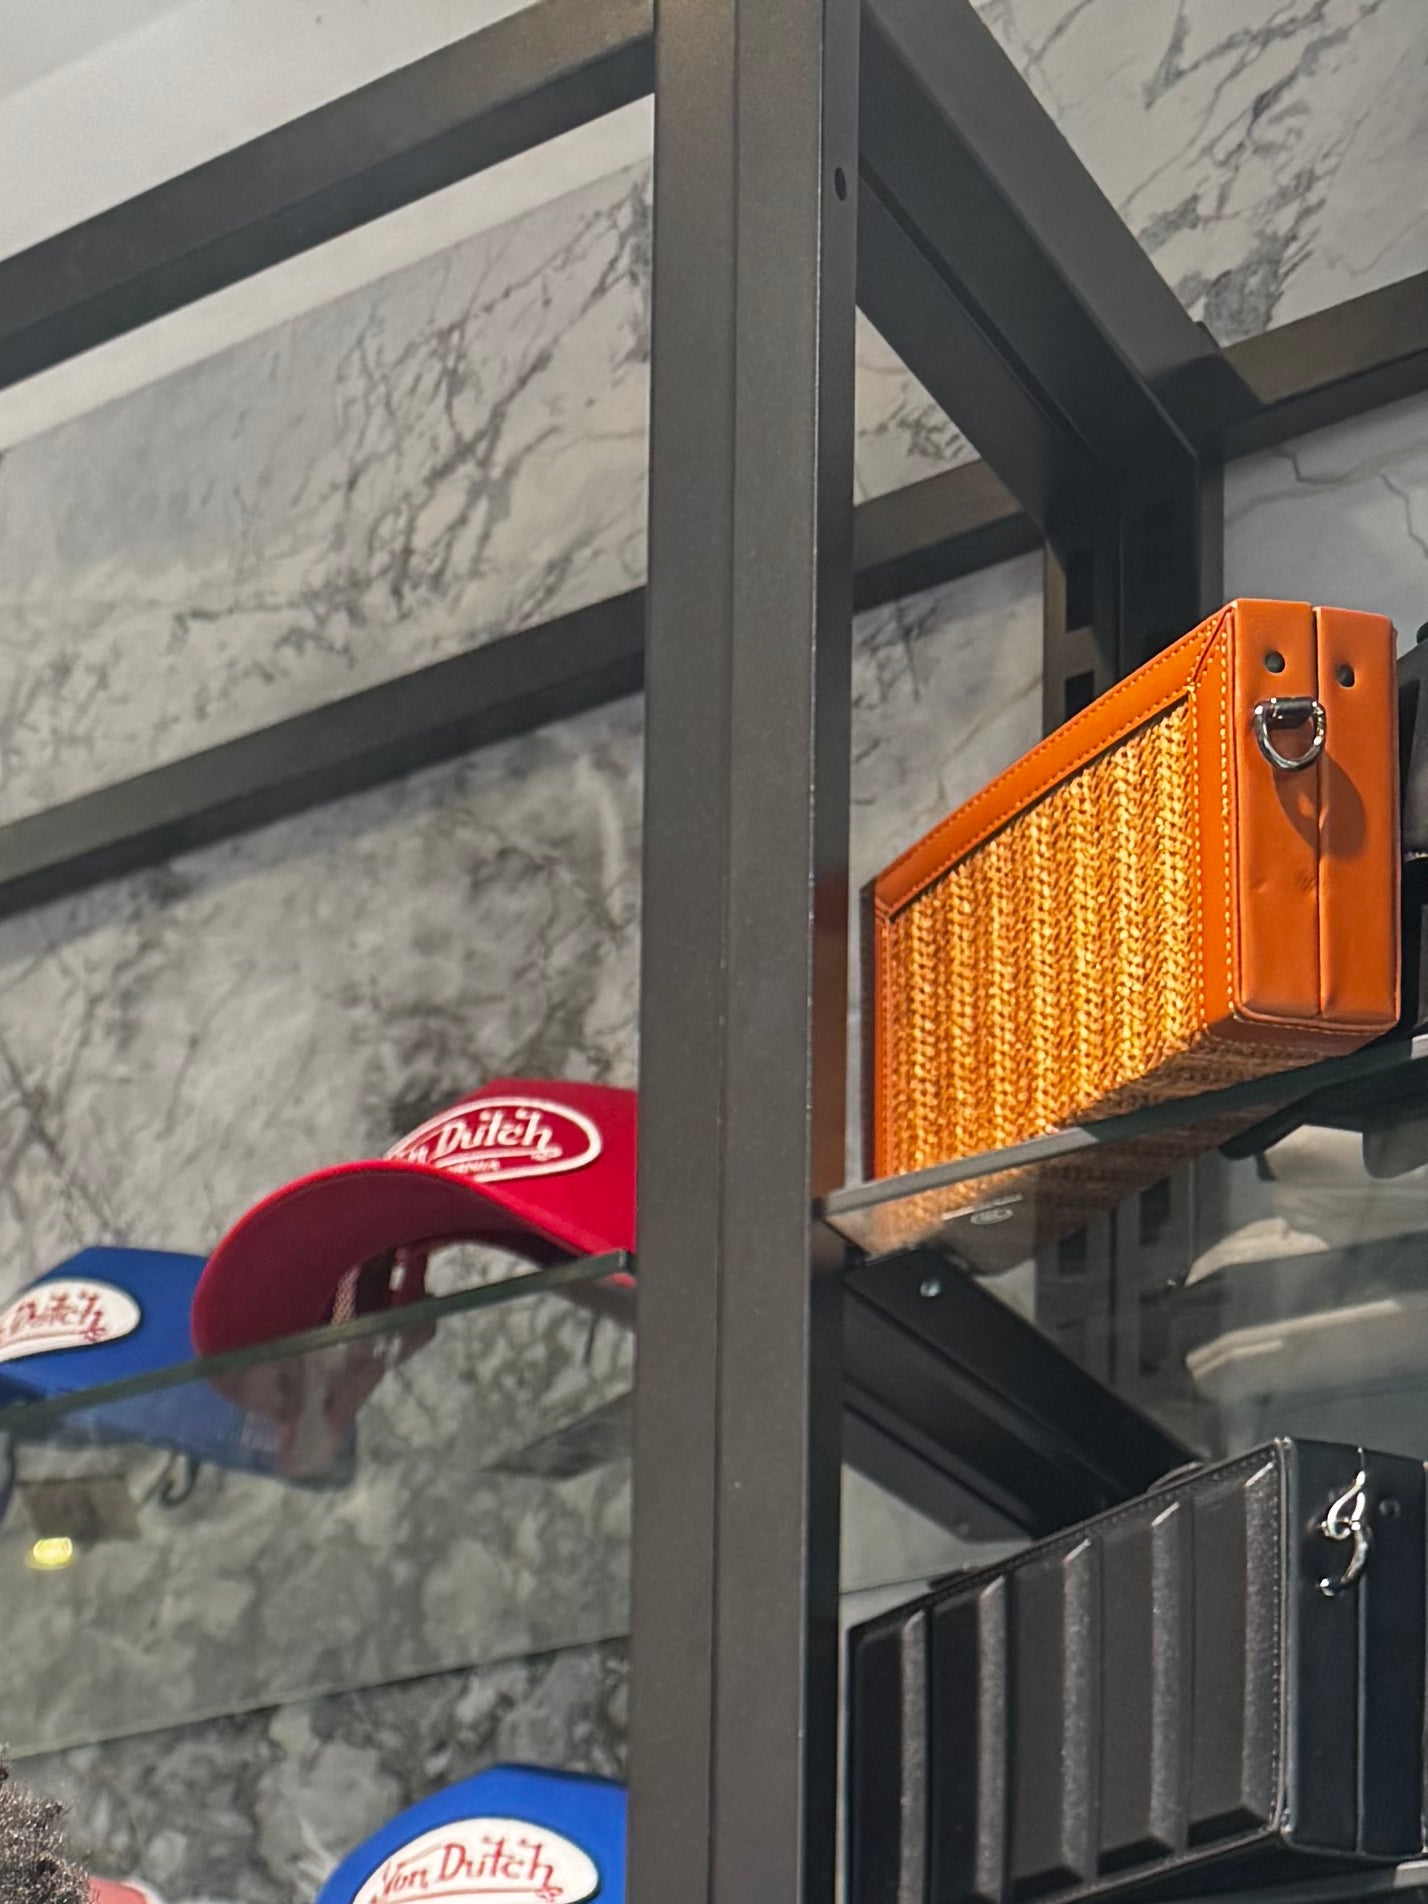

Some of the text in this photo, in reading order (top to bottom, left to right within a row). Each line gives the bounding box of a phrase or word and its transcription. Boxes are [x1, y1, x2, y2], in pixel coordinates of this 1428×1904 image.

[432, 1107, 558, 1162] Dutch
[379, 1835, 558, 1897] Von Dutch
